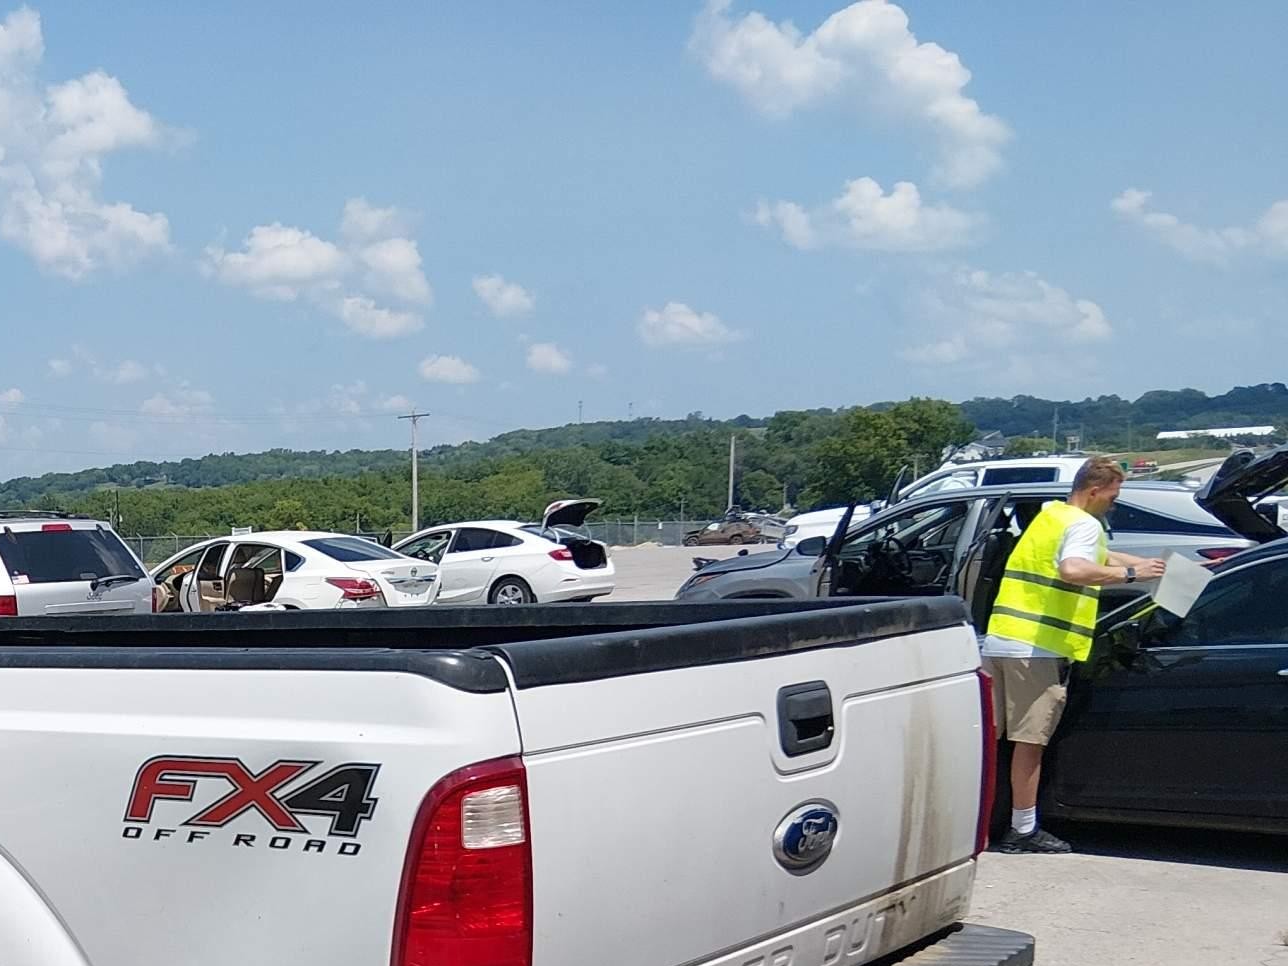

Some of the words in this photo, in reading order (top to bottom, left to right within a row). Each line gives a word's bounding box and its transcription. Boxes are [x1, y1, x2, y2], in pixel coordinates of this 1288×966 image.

[122, 754, 382, 838] FX4
[121, 825, 211, 844] OFF
[231, 833, 362, 856] ROAD
